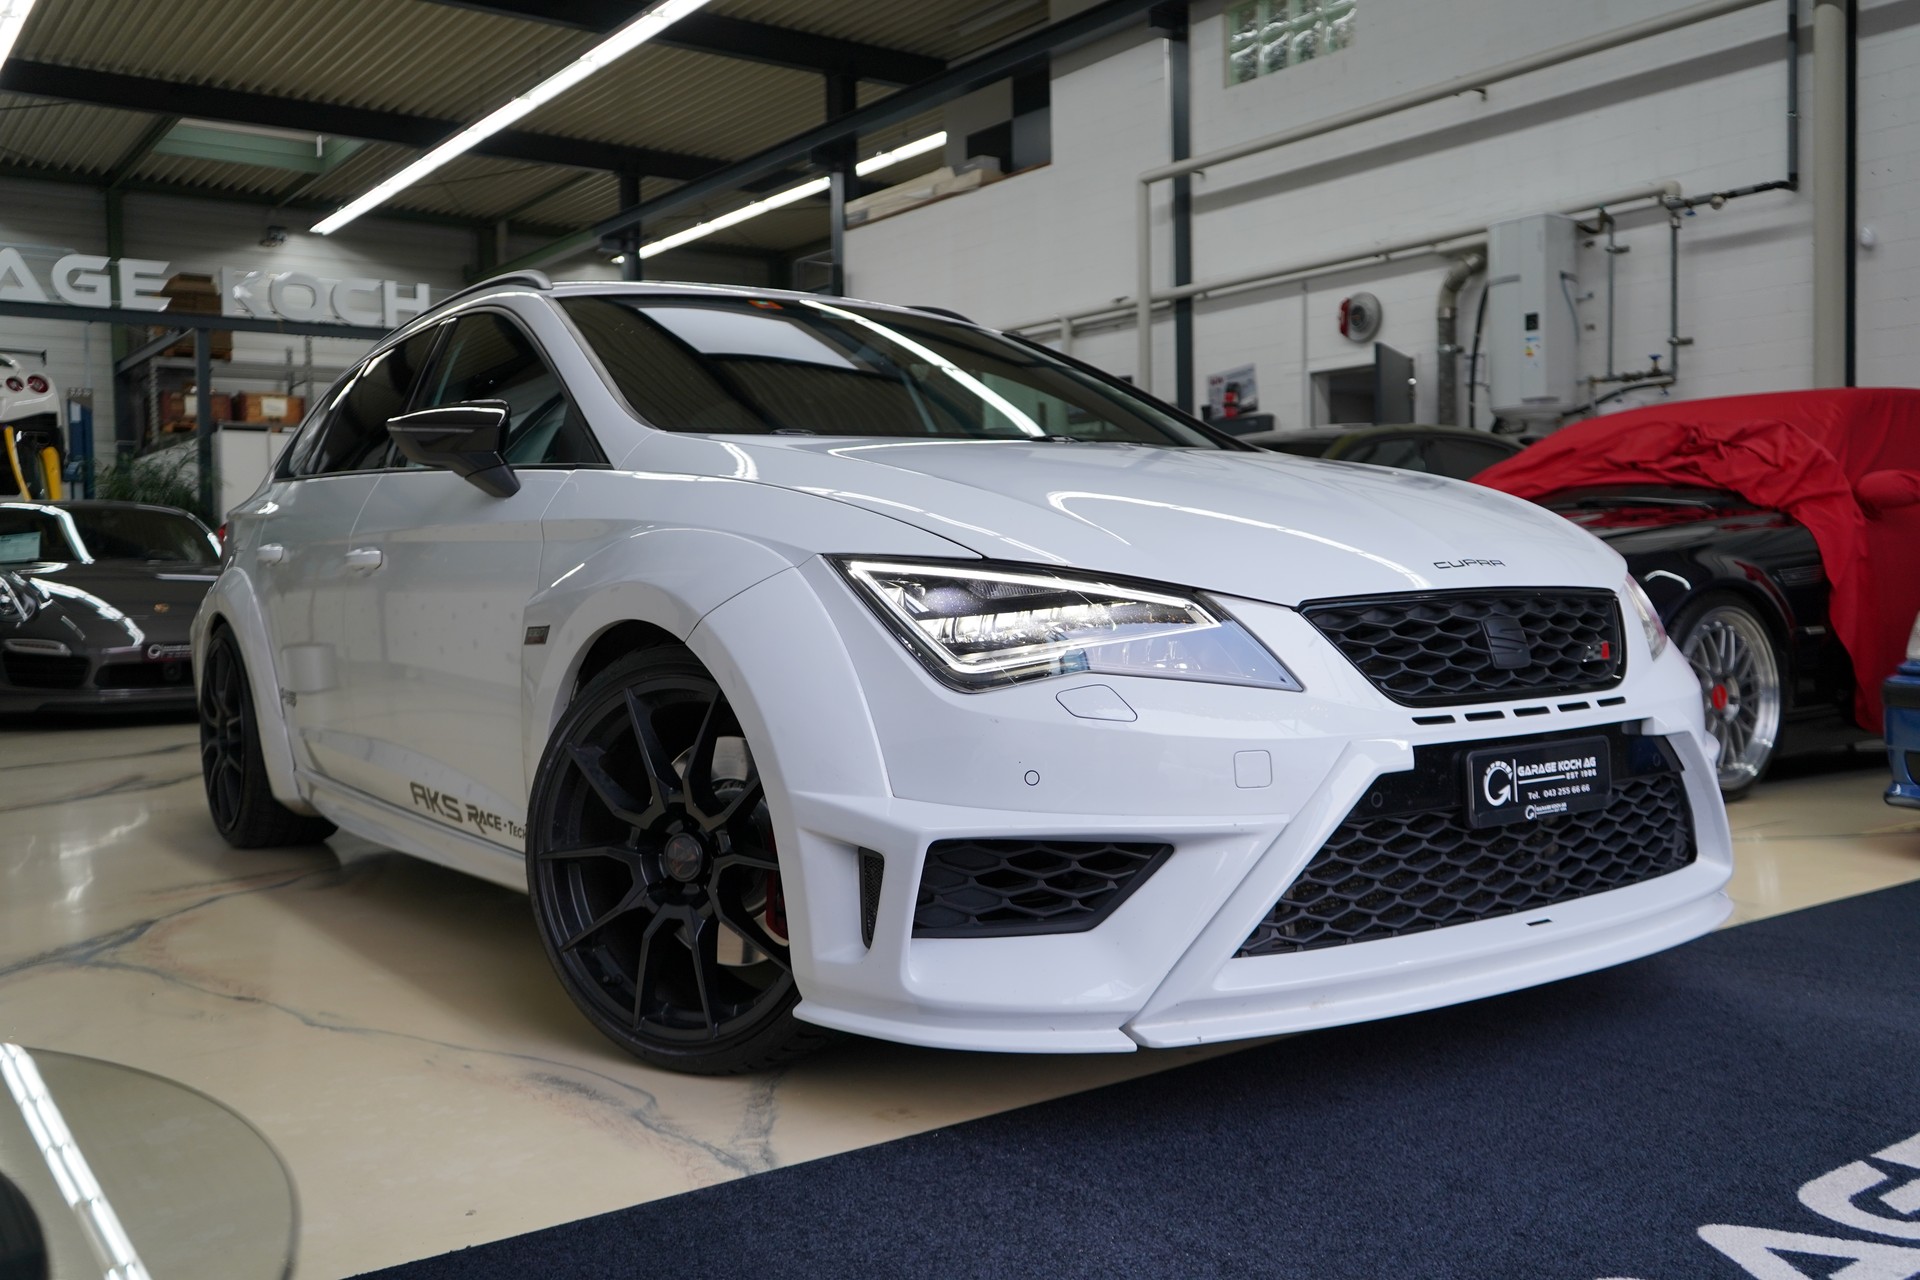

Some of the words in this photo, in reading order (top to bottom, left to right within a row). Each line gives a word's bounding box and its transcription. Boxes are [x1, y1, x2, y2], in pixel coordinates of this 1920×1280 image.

[221, 267, 430, 330] KOCH
[1433, 559, 1506, 569] CUPRA
[1517, 763, 1557, 776] GARAGE
[1558, 759, 1582, 771] KOCH
[1583, 757, 1596, 768] AG
[410, 781, 463, 824] AKS
[1528, 791, 1540, 800] Tel.
[1543, 789, 1557, 798] 043
